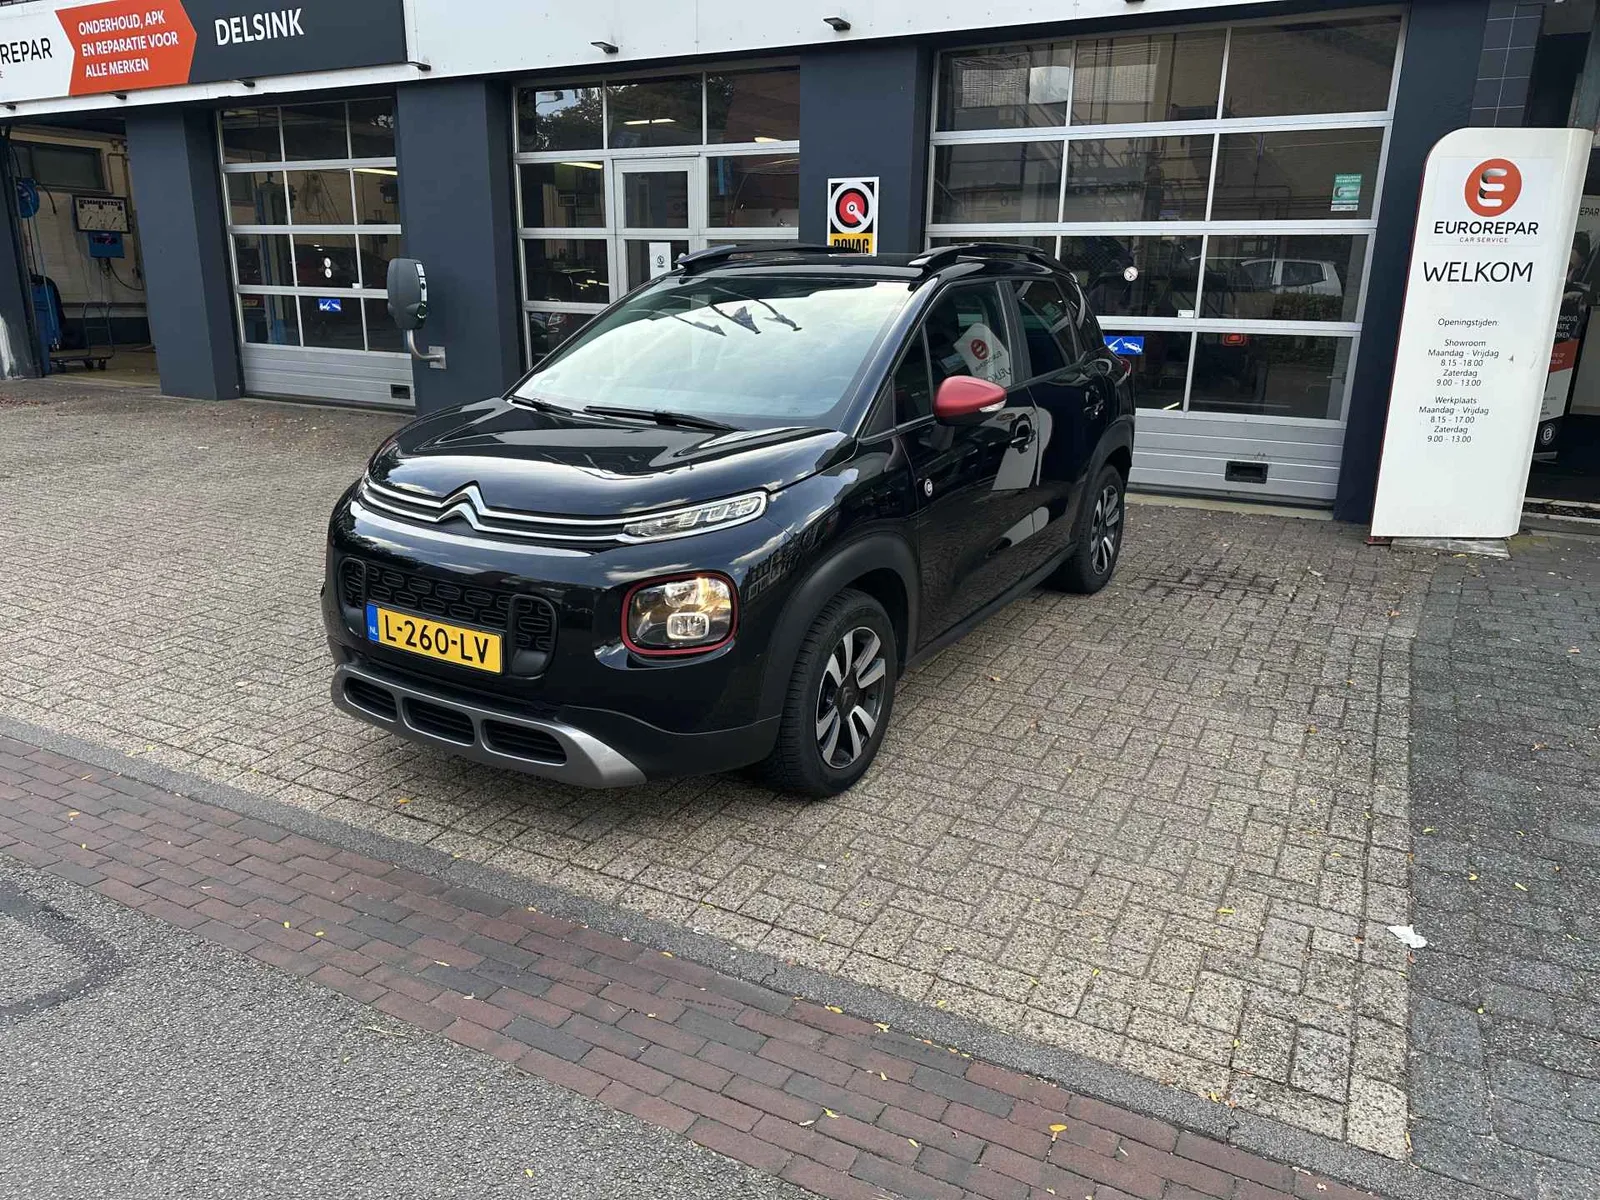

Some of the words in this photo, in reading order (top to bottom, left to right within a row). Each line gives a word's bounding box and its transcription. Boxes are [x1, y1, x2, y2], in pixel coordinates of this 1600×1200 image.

[78, 14, 144, 35] ONDERHOUD,
[145, 10, 166, 26] APK
[214, 8, 304, 46] DELSINK
[81, 42, 95, 57] EN
[96, 35, 147, 55] REPARATIE
[147, 31, 179, 48] VOOR
[0, 37, 53, 64] REPAR
[85, 61, 107, 78] ALLE
[108, 58, 149, 75] MERKEN
[1433, 221, 1539, 235] EUROREPAR
[1423, 261, 1534, 282] WELKOM
[1437, 318, 1500, 328] Openingstijden:
[1444, 339, 1486, 347] Showroom
[1427, 349, 1464, 358] Maandag
[1472, 349, 1499, 359] Vrijdag
[1440, 359, 1457, 367] 8.15
[1443, 369, 1478, 378] Zaterdag
[1436, 379, 1453, 387] 9.00
[1461, 379, 1482, 387] 13.00
[1435, 396, 1477, 405] Werkplaats
[1419, 406, 1455, 415] Maandag
[1463, 406, 1489, 415] Vrijdag
[1434, 426, 1468, 434] Zaterdag
[369, 626, 378, 636] NL
[385, 615, 488, 664] L-260-LV
